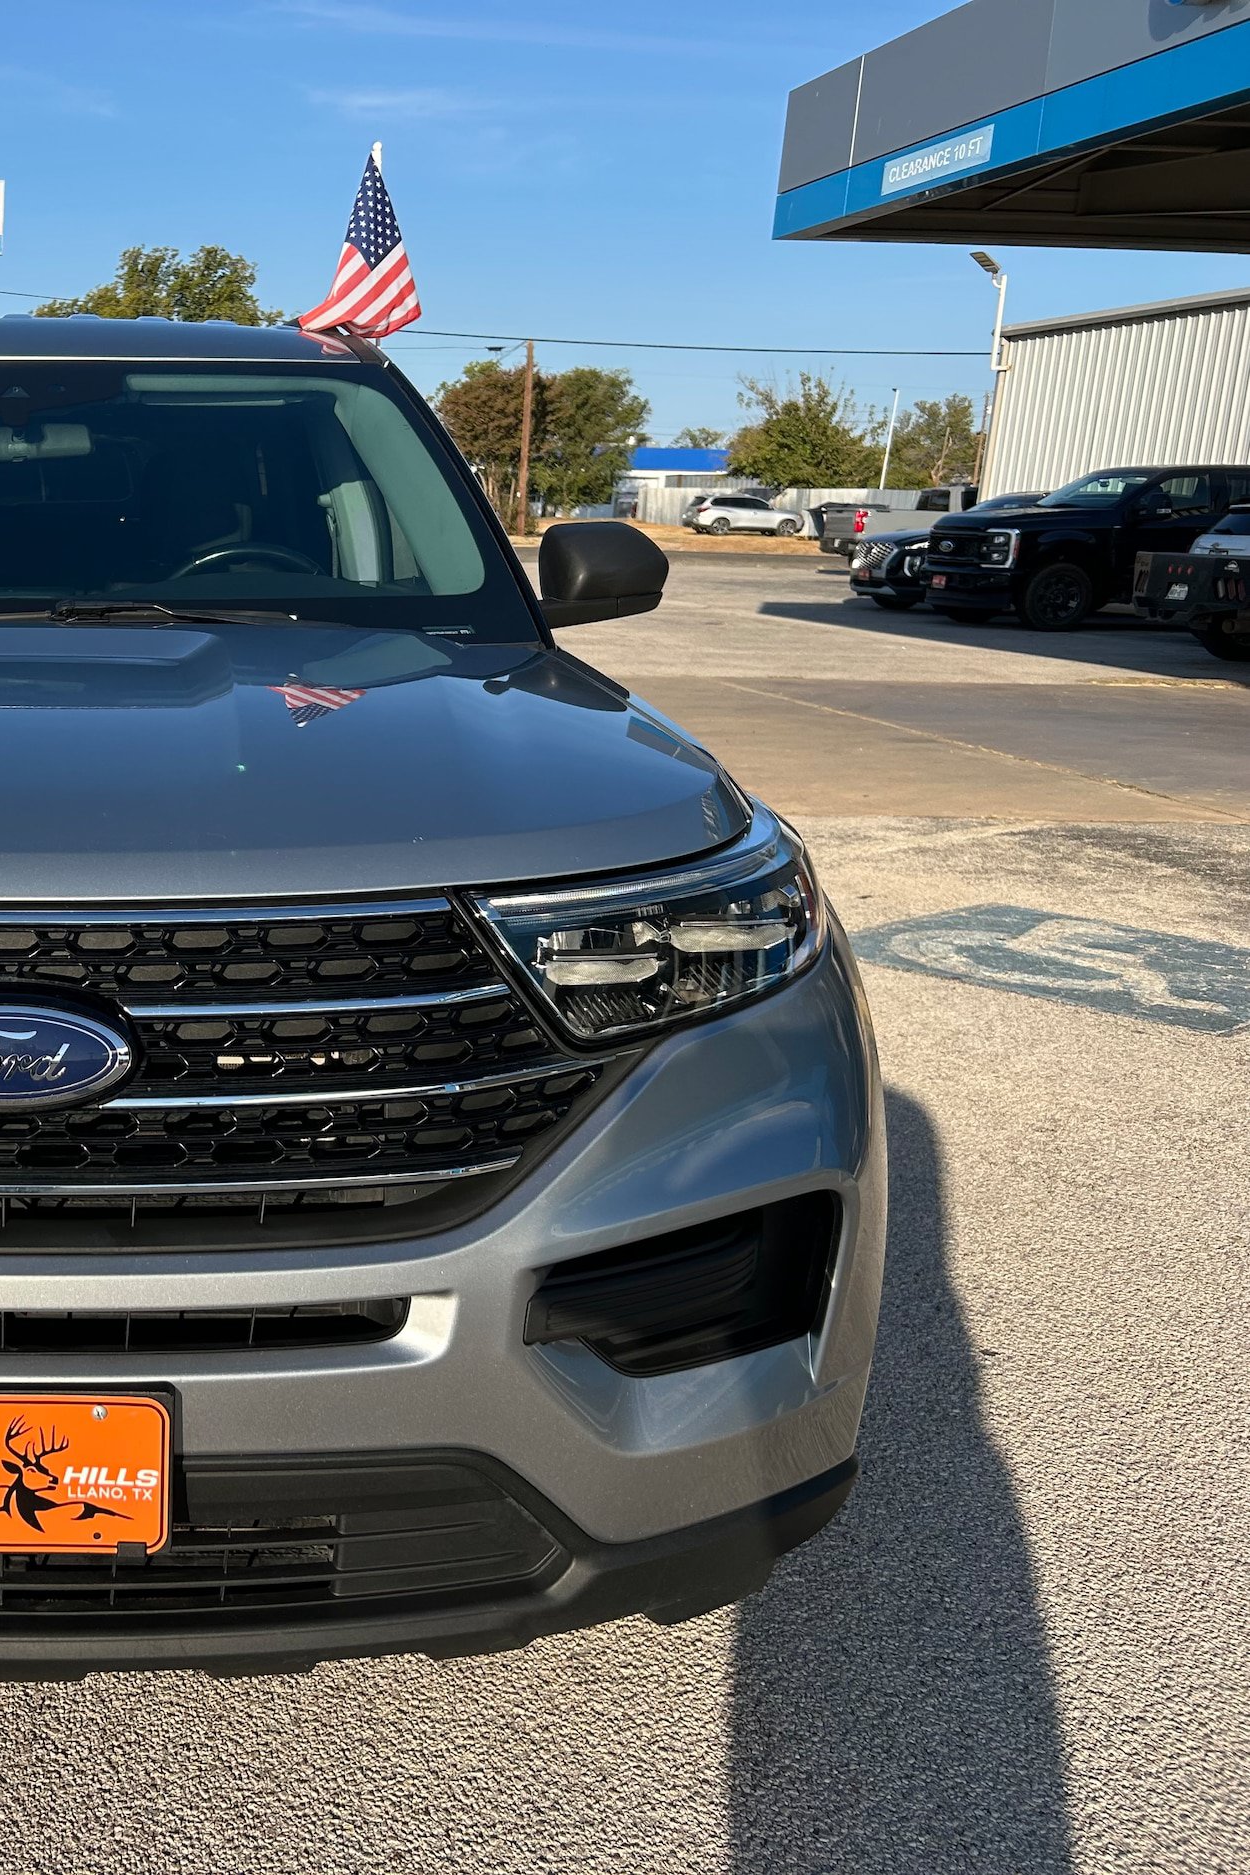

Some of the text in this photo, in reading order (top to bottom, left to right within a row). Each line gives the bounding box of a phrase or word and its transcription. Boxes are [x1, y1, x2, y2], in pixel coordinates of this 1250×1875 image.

[888, 136, 983, 183] CLEARANCE 10 FT
[62, 1466, 159, 1487] HILLS
[67, 1486, 153, 1501] LLANO, TX
